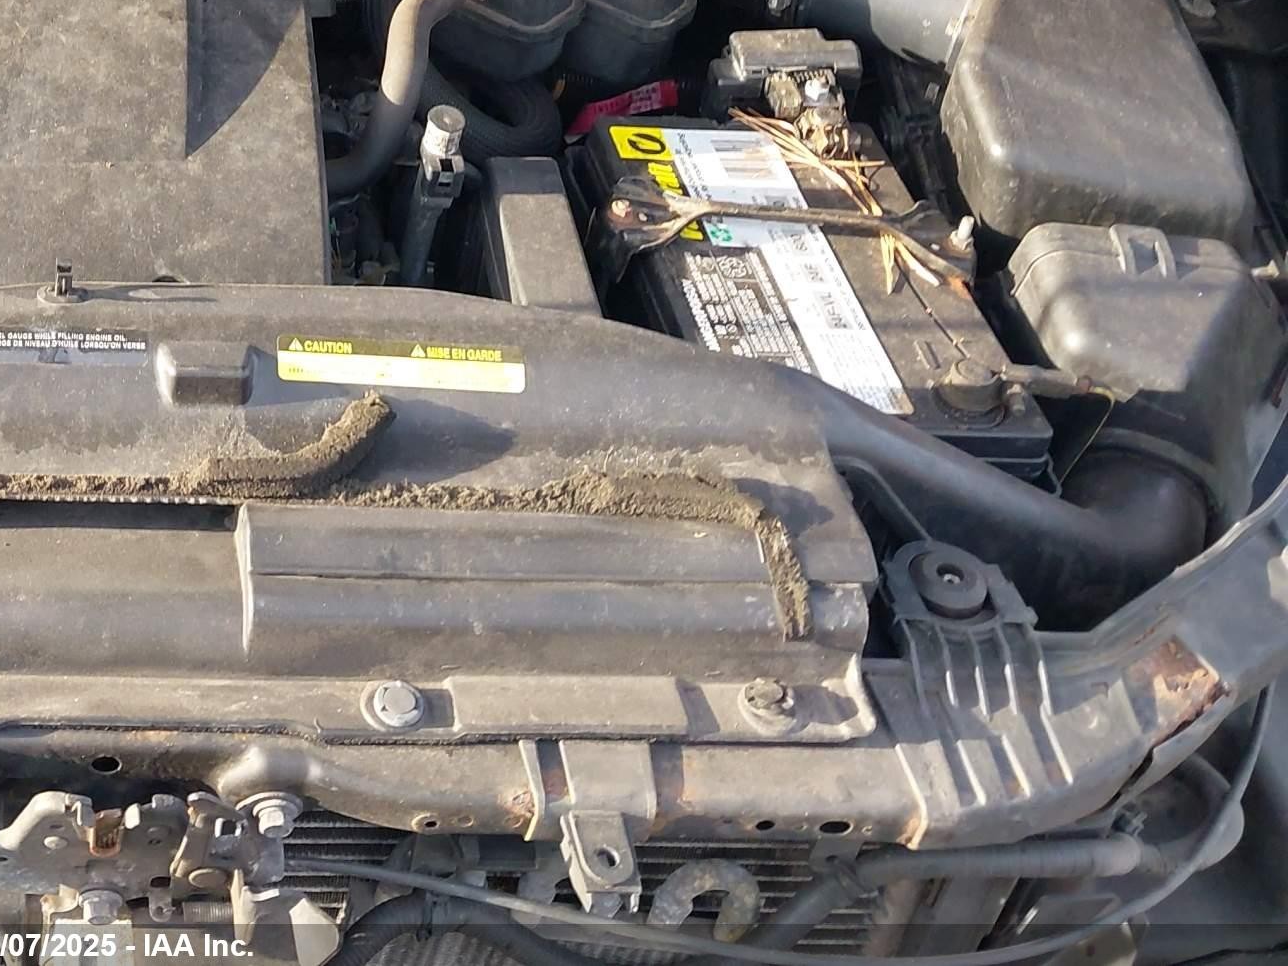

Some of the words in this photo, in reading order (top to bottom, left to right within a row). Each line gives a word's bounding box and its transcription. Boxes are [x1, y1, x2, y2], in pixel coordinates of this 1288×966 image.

[304, 340, 353, 355] CAUTION
[426, 346, 451, 359] MISE
[452, 347, 467, 360] EN
[467, 348, 502, 362] GARDE
